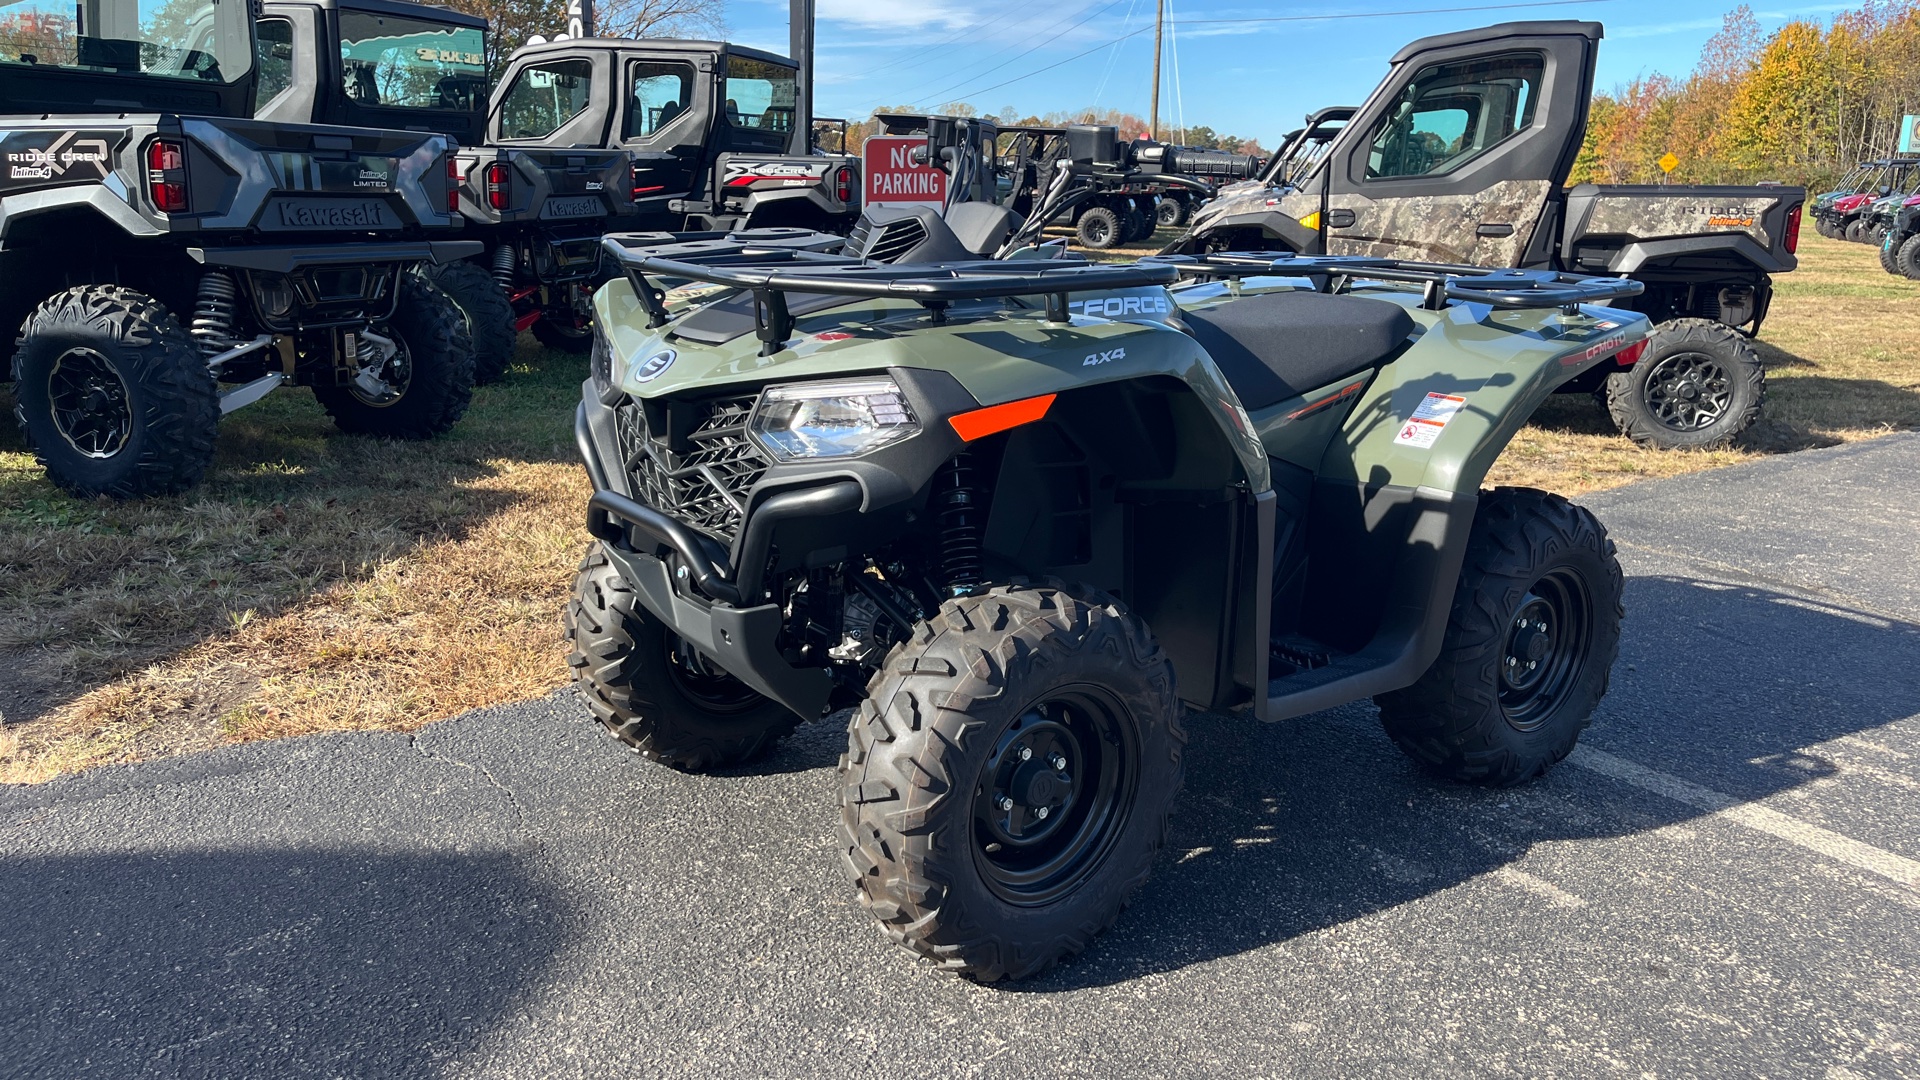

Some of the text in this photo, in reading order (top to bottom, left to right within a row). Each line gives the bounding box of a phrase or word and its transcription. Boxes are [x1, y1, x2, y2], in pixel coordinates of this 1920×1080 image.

[8, 153, 105, 162] RIDGE CREW
[873, 173, 939, 195] PARKING
[279, 202, 384, 227] Kawasaki
[548, 200, 599, 217] Kawasaki
[1682, 206, 1756, 216] RIDGE
[1585, 330, 1627, 361] CFMOTO
